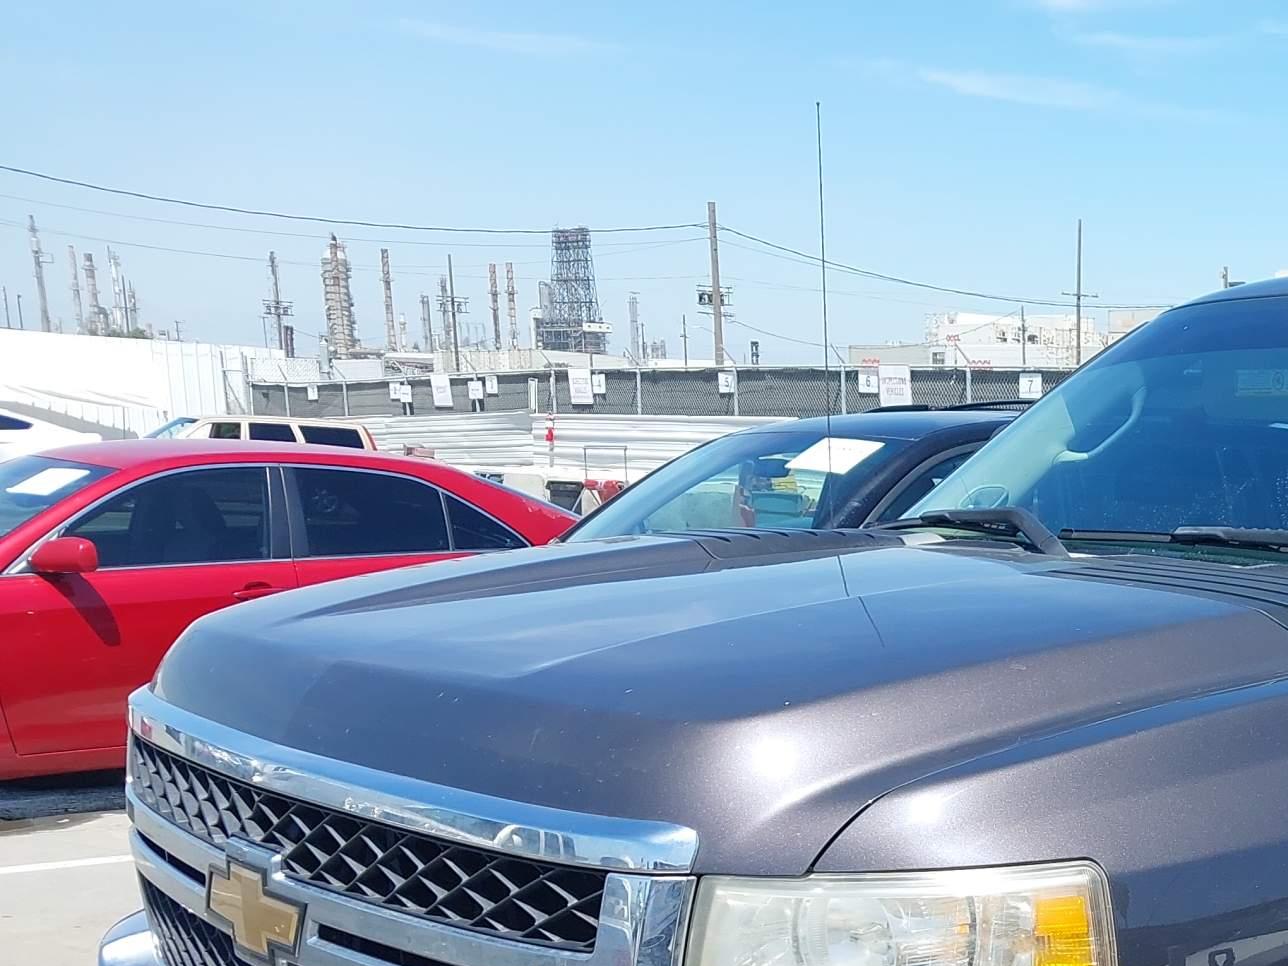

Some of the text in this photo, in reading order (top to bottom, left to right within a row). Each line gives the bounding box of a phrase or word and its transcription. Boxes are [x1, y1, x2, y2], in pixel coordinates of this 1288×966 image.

[723, 378, 730, 388] 5
[865, 375, 871, 387] 6
[1027, 380, 1034, 393] 7
